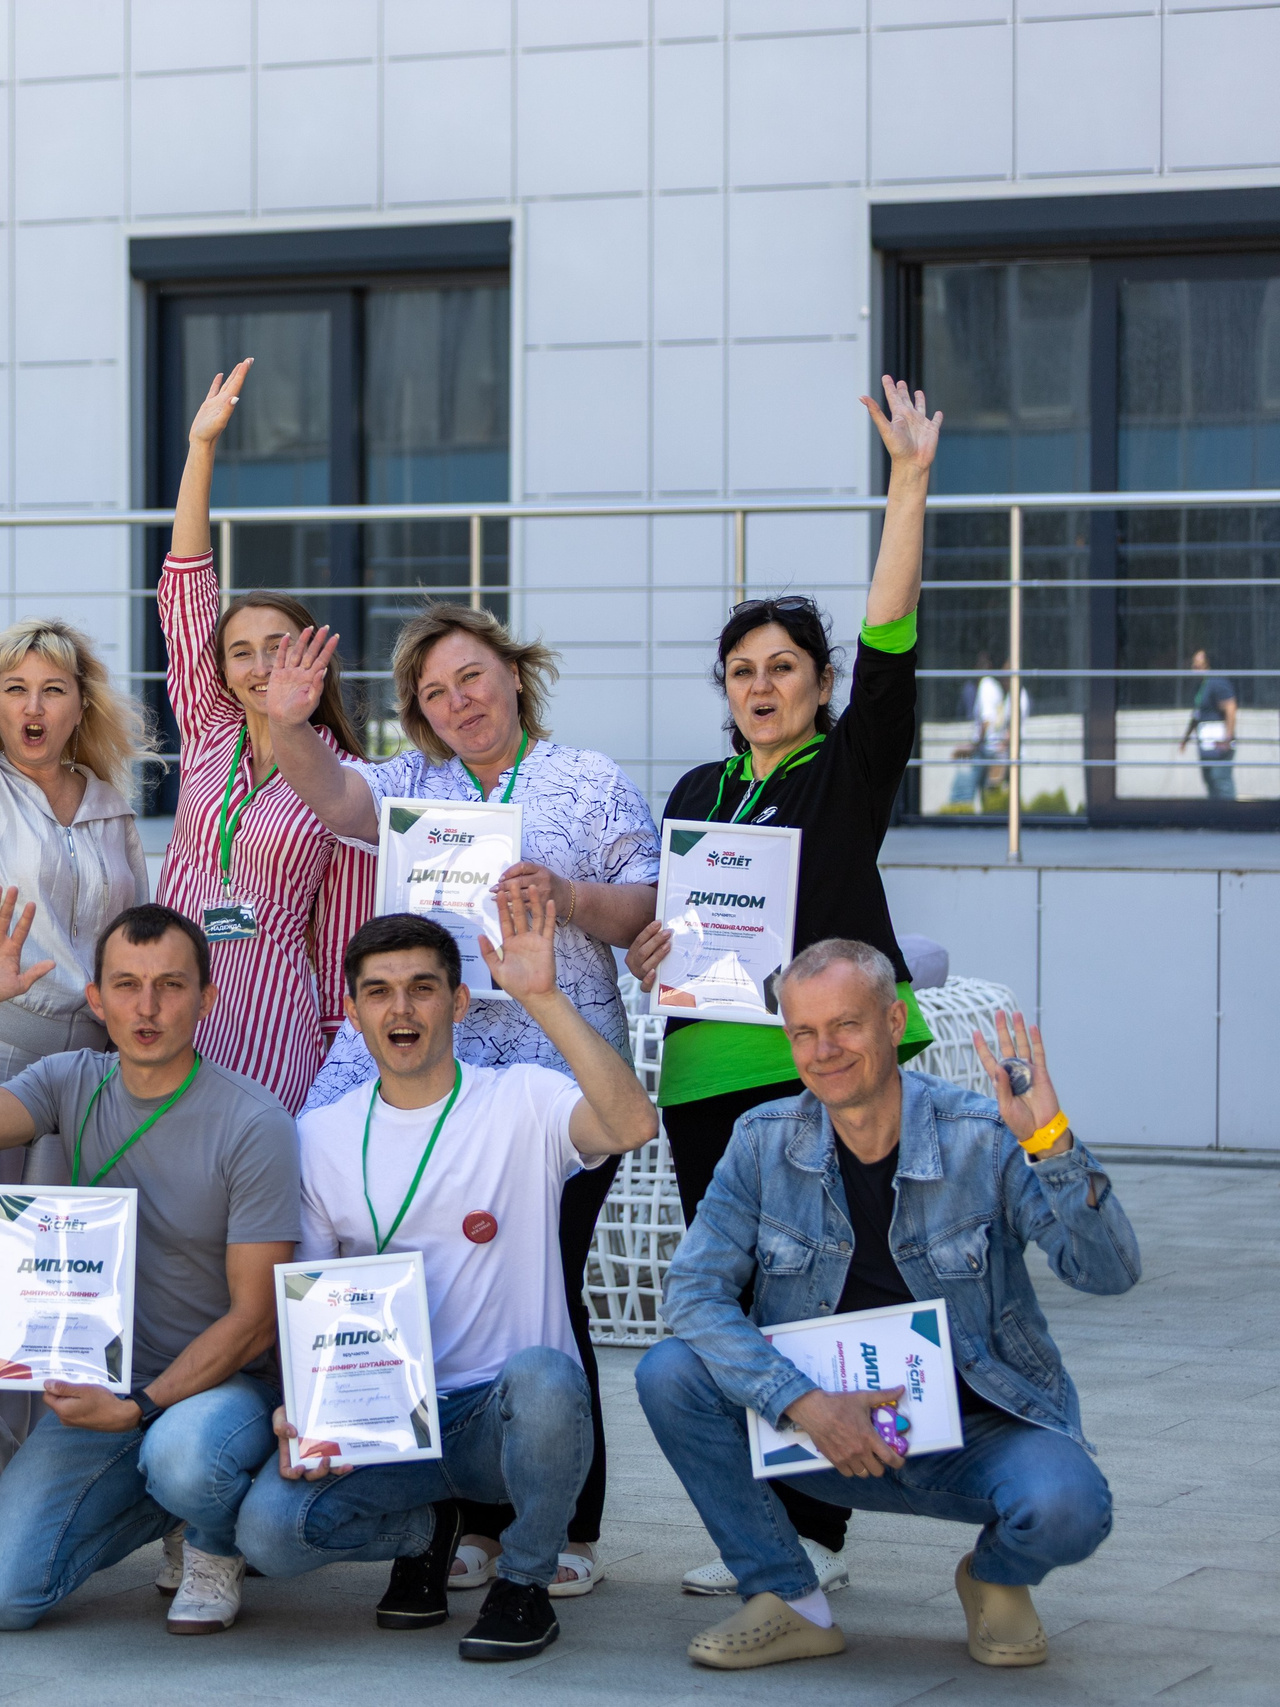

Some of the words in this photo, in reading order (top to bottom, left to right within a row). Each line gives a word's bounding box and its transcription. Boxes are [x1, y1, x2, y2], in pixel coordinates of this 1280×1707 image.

[442, 832, 475, 843] СЛЁТ
[720, 856, 752, 867] СЛЁТ
[407, 868, 490, 885] ДИПЛОМ
[442, 900, 475, 908] САВЕНКО
[685, 890, 766, 909] ДИПЛОМ
[710, 923, 764, 933] ПОШИВАЛОВОЙ
[54, 1219, 87, 1231] СЛЁТ
[17, 1258, 104, 1274] ДИПЛОМ
[343, 1288, 376, 1302] СЛЁТ
[312, 1328, 398, 1350] ДИПЛОМ
[359, 1359, 404, 1368] ШУГАЙЛОВУ
[836, 1340, 847, 1376] ДМИТРИЮ
[860, 1342, 880, 1391] ДИПЛ
[910, 1368, 924, 1402] СЛЁТ
